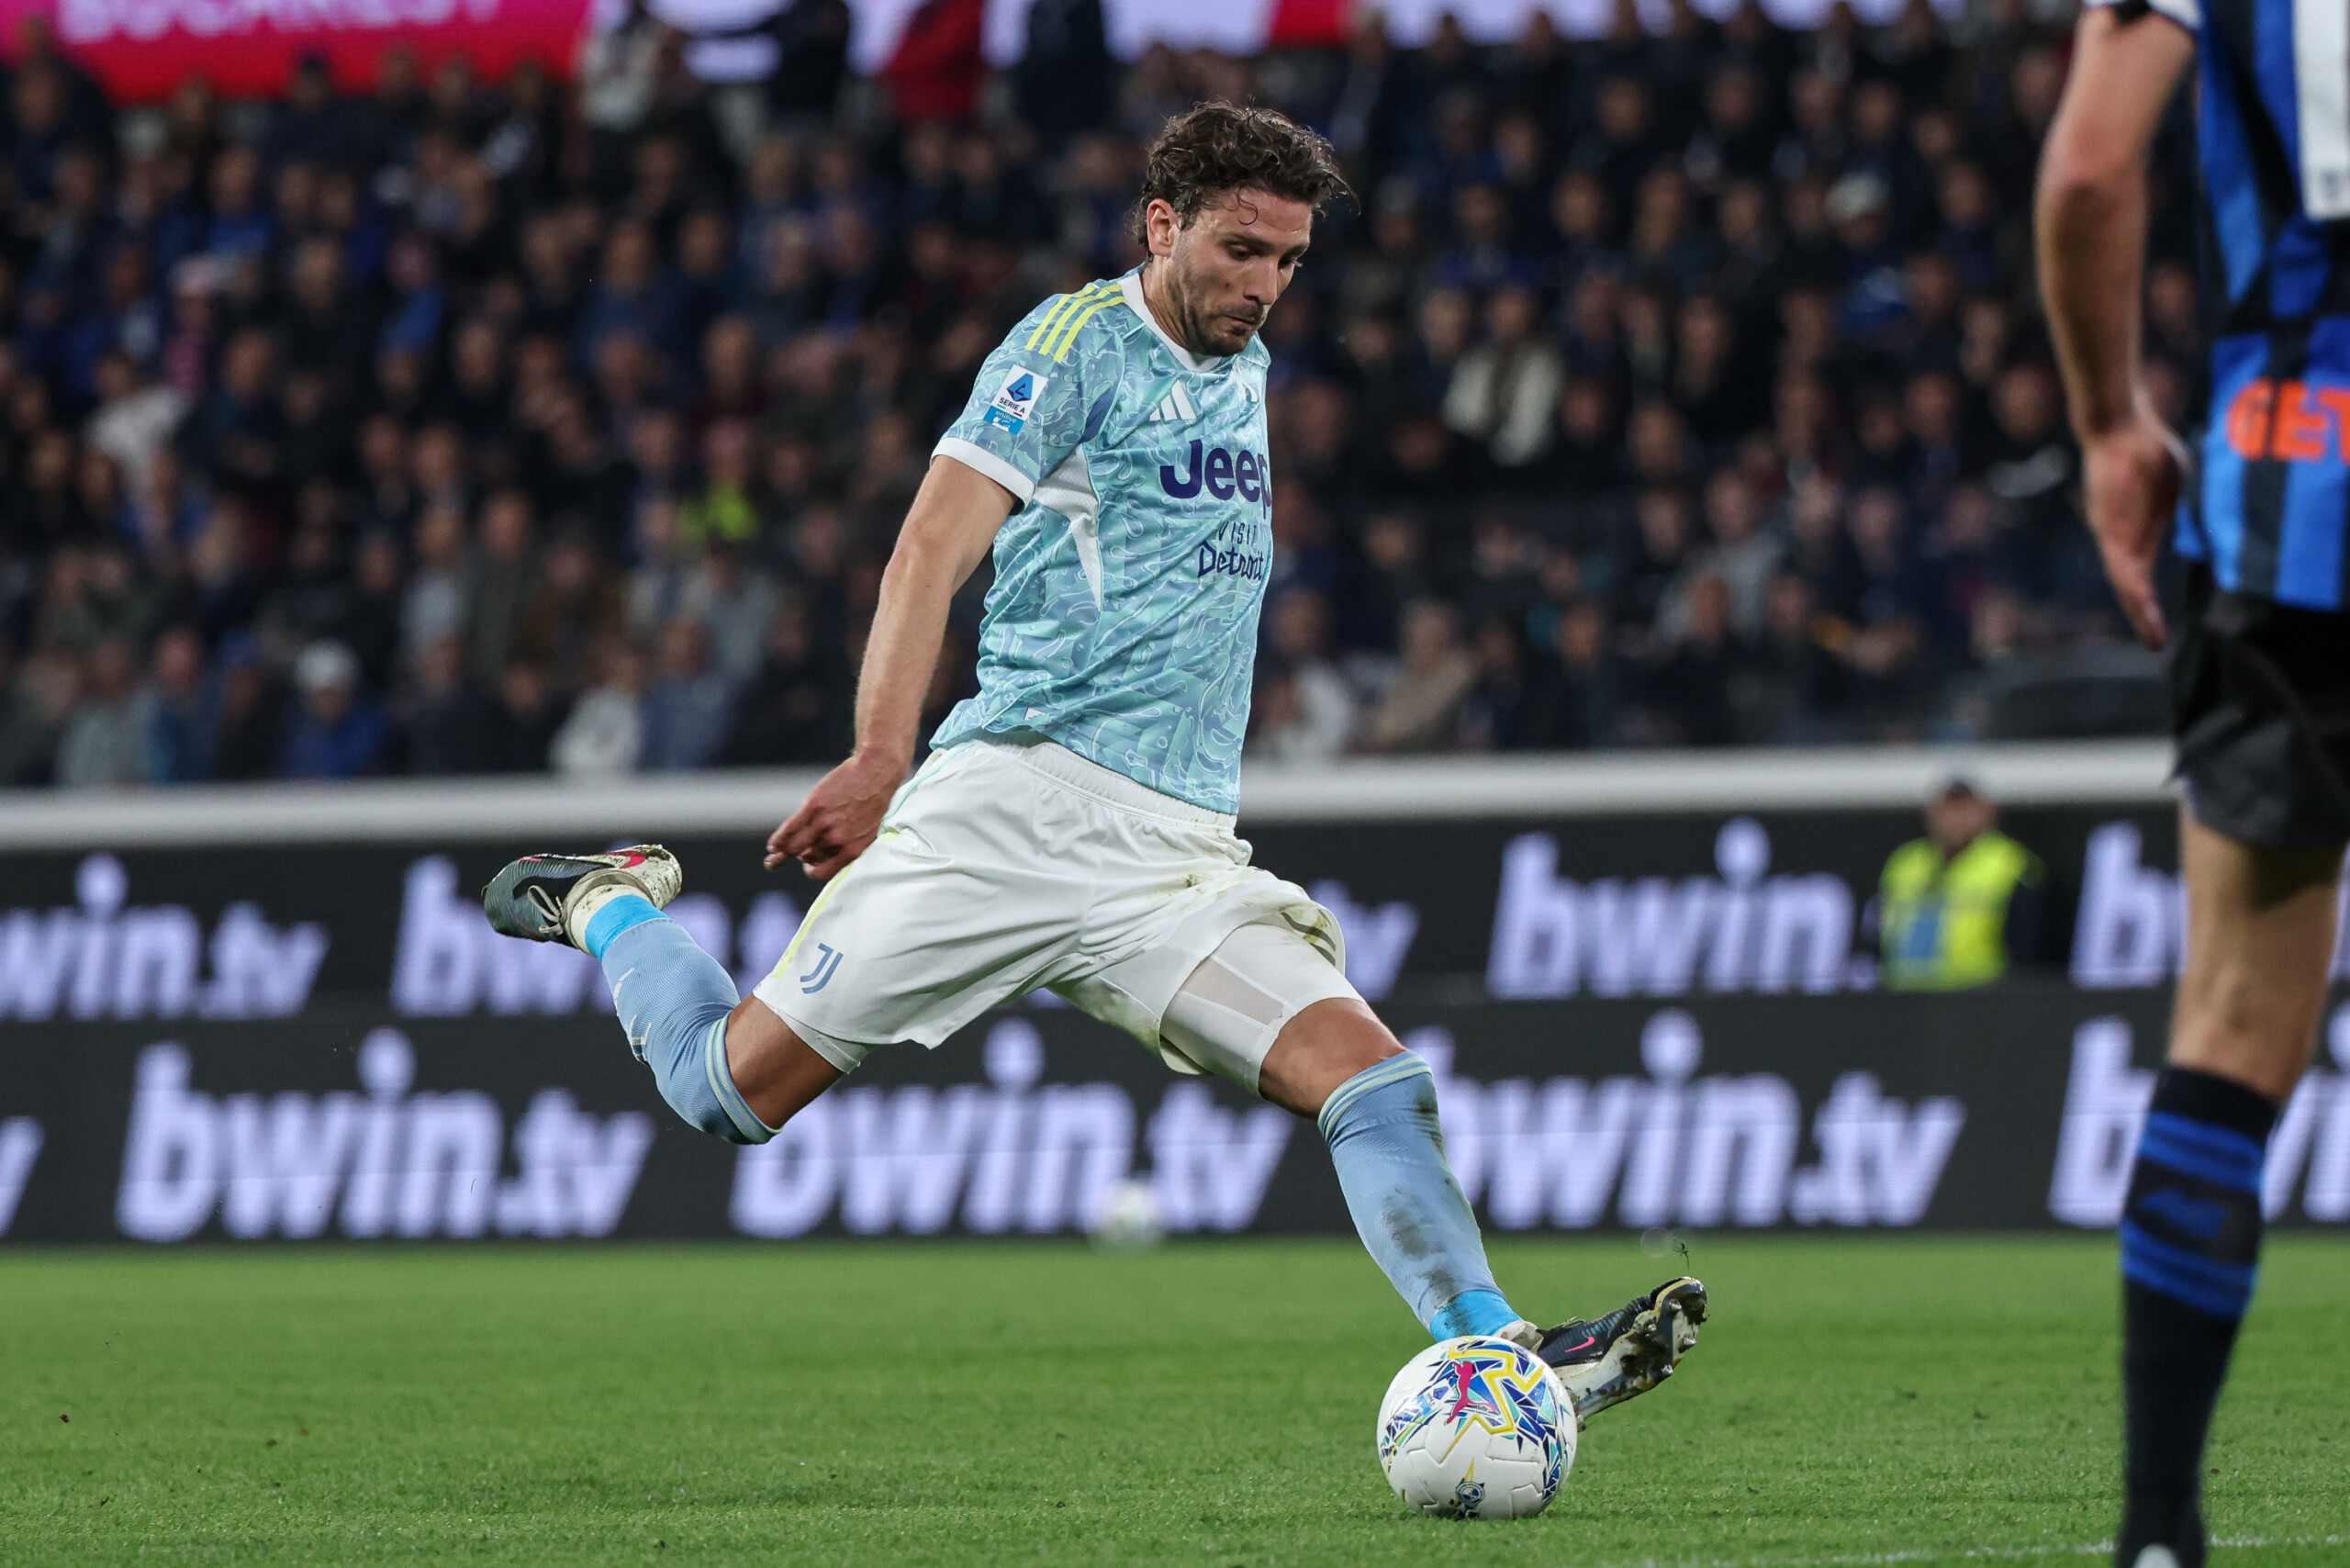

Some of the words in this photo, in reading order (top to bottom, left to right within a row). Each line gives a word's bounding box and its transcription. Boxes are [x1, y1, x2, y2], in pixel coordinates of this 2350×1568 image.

[999, 397, 1021, 411] SERIE
[1159, 439, 1272, 520] Jeep
[0, 851, 330, 1020] win.tv
[1483, 817, 1880, 1001] bwin.
[115, 1025, 655, 1241] bwin.tv
[728, 1017, 1294, 1239] bwintv
